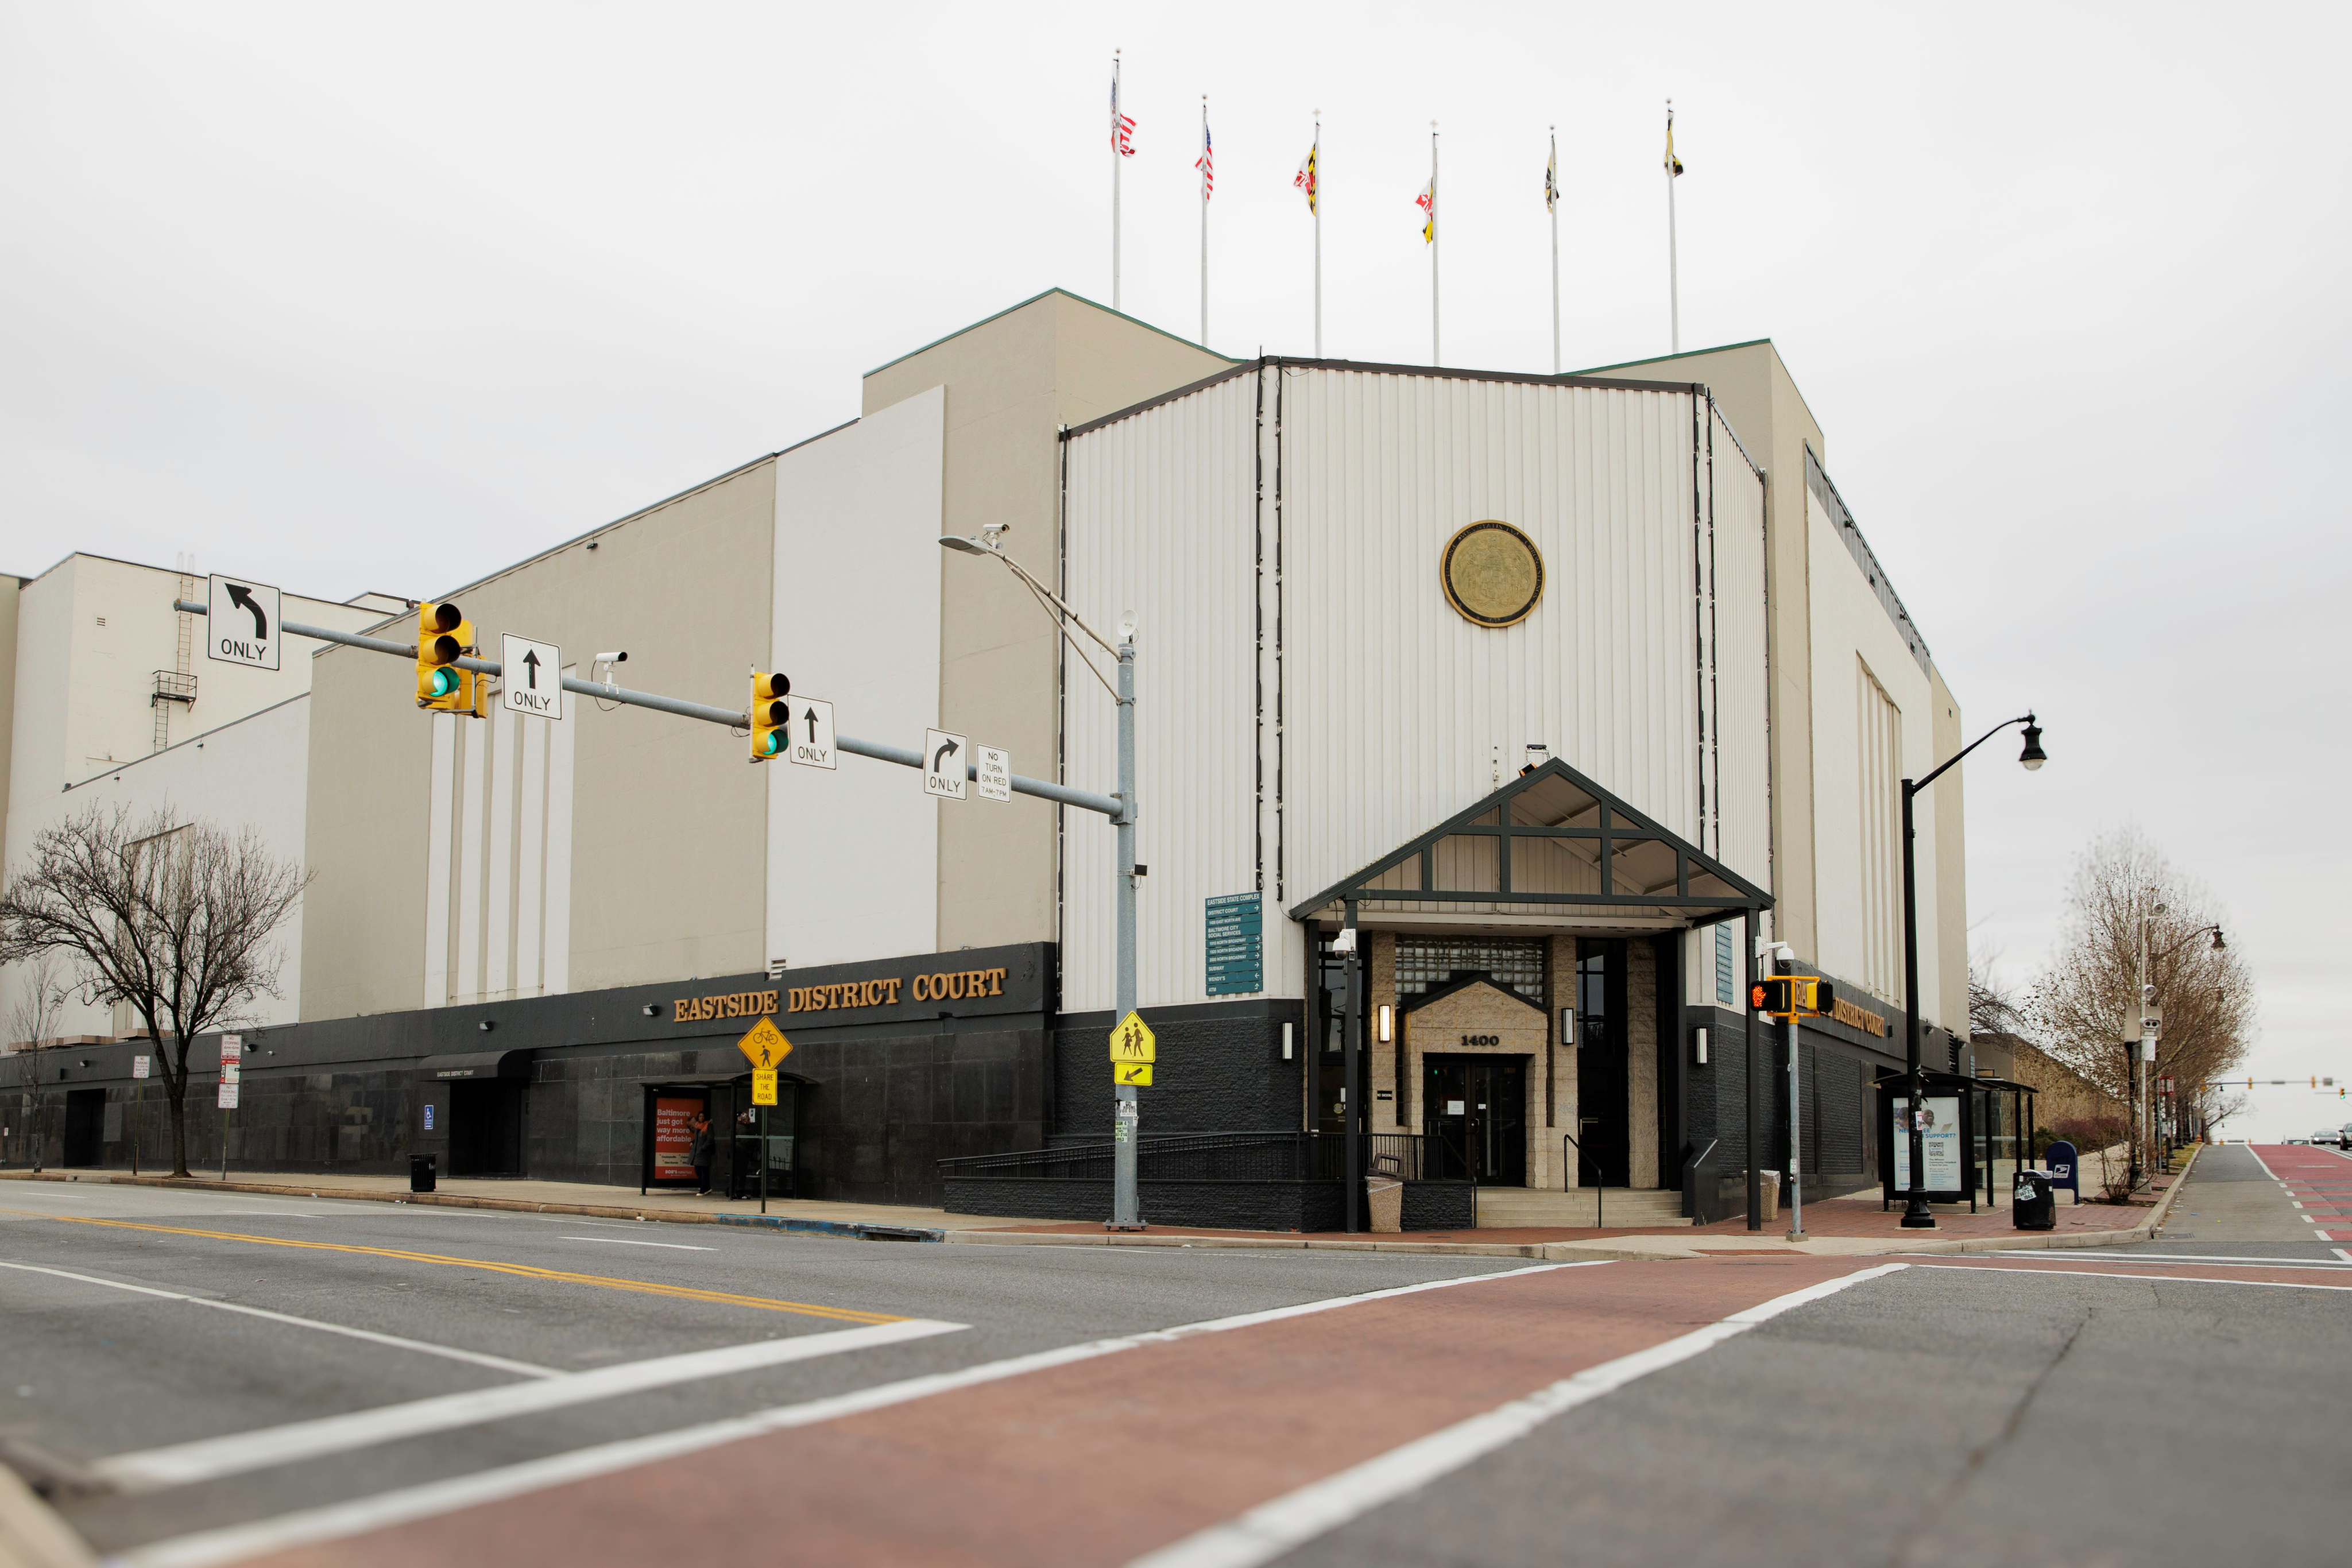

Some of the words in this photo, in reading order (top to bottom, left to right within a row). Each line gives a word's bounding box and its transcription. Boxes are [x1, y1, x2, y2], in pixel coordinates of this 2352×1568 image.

[221, 638, 267, 661] ONLY
[514, 691, 551, 711] ONLY
[798, 746, 827, 762] ONLY
[988, 752, 999, 761] NO
[985, 762, 1003, 774] TURN
[930, 776, 961, 793] ONLY
[982, 774, 991, 783] ON
[993, 776, 1007, 786] RED
[1207, 897, 1227, 905] EASTSIDE
[674, 990, 779, 1022] EASTSIDE
[788, 978, 902, 1013] DISTRICT
[912, 968, 1006, 1001] COURT
[1834, 996, 1864, 1030] DISTRICT
[1864, 1010, 1885, 1037] COURT
[1461, 1035, 1499, 1046] 1400
[656, 1117, 670, 1125] just
